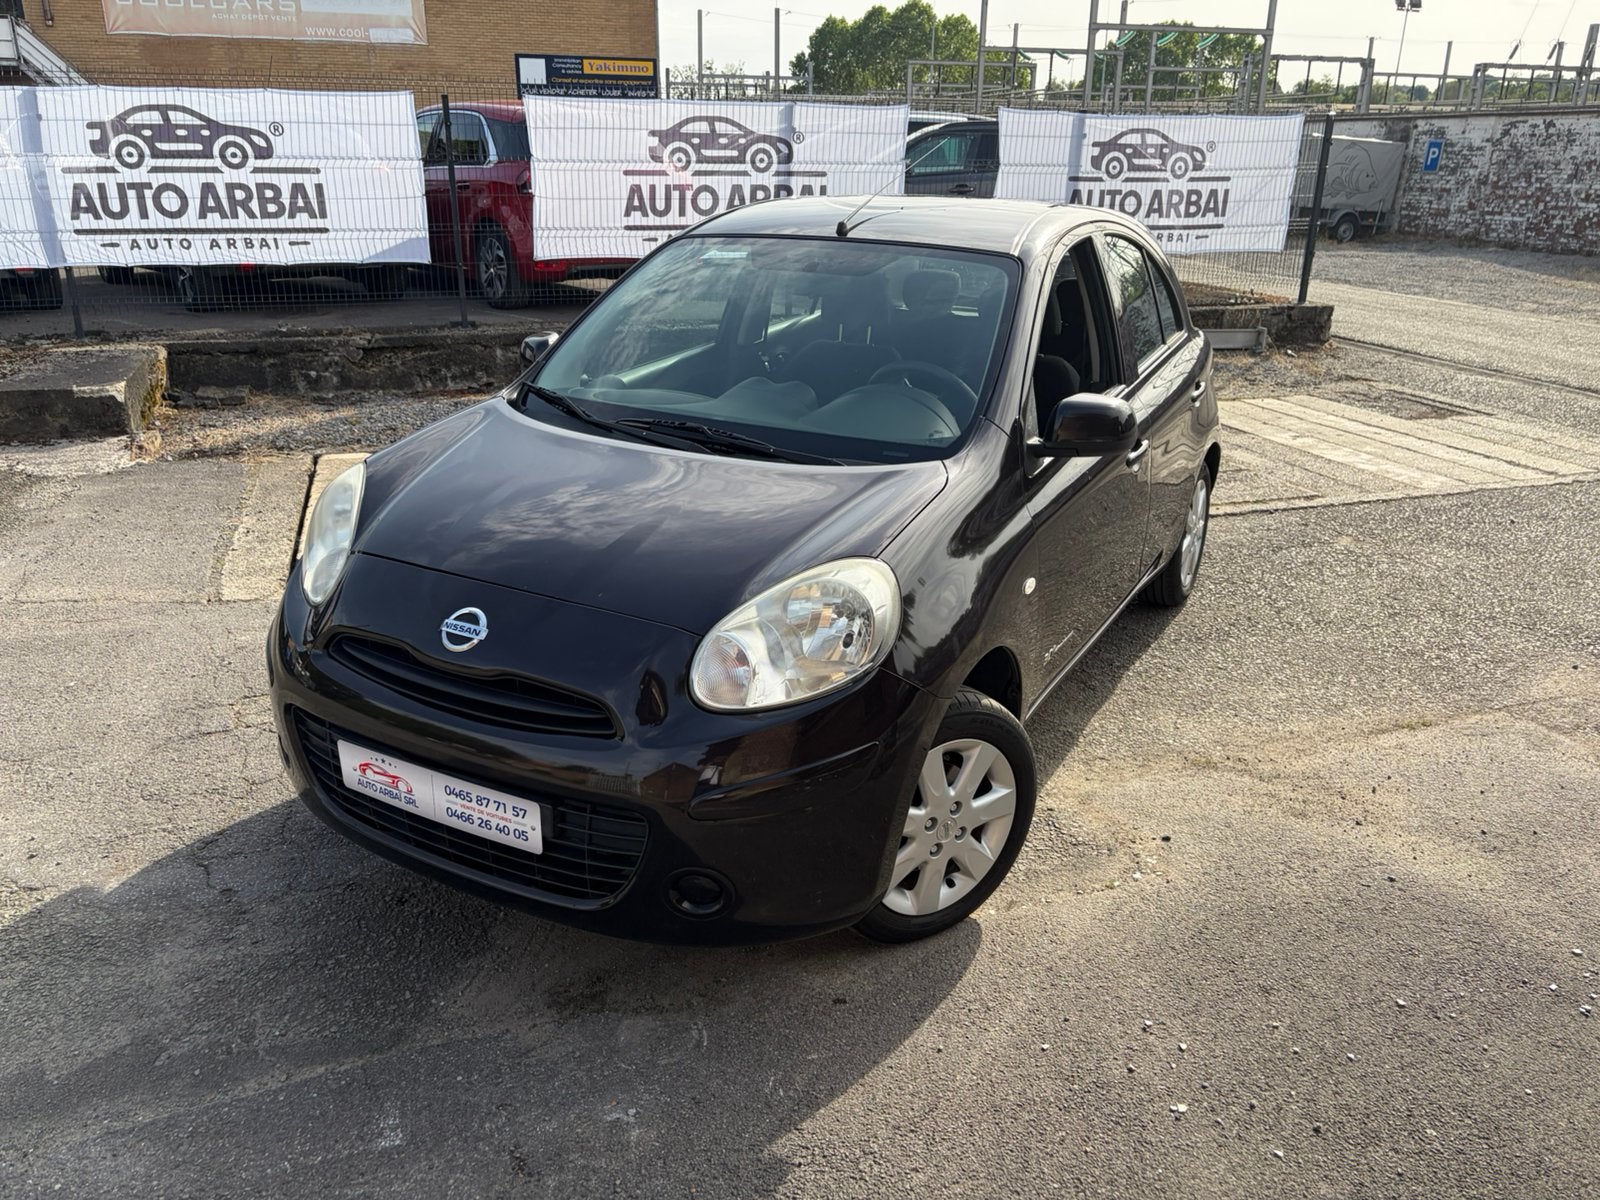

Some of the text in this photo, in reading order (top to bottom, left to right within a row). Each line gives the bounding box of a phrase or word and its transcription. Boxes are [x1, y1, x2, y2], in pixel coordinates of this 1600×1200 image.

[588, 61, 649, 73] Yakimmo
[1427, 148, 1439, 165] P
[71, 182, 328, 220] AUTO ARBAI
[624, 184, 720, 217] AUTO
[1145, 188, 1230, 218] ARBAI
[130, 237, 280, 250] AUTO ARBAI
[1157, 233, 1190, 243] RBAI
[444, 621, 481, 636] NISSAN
[357, 778, 419, 808] AUTO ARBAI SRL
[444, 785, 527, 819] 0465 87 71 57
[460, 803, 477, 813] VENTE
[446, 807, 529, 842] 0466 26 40 05
